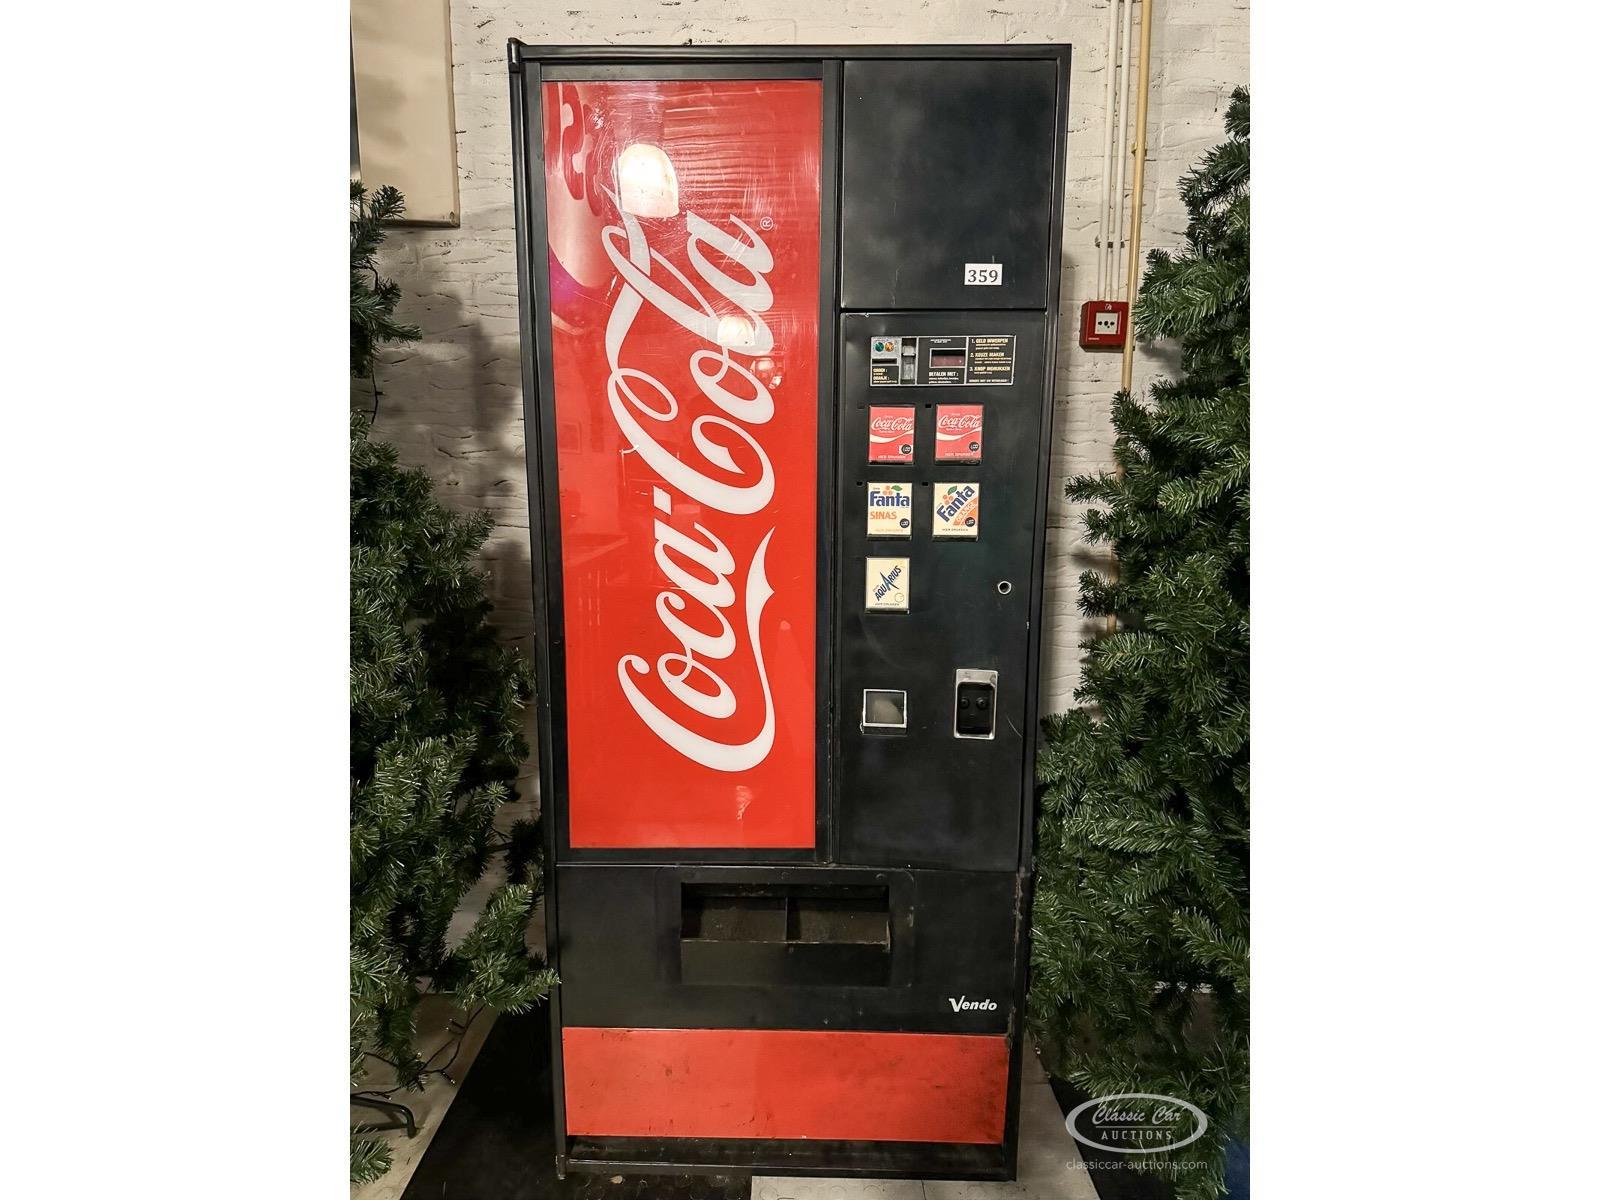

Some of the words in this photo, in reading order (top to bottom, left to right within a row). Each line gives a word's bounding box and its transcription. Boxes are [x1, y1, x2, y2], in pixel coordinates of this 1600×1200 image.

[968, 269, 998, 283] 359
[602, 186, 777, 773] Coca-Cola
[870, 491, 910, 506] Fanta
[936, 486, 975, 522] Fanta
[870, 511, 897, 520] SINAS
[948, 995, 998, 1012] Vendo
